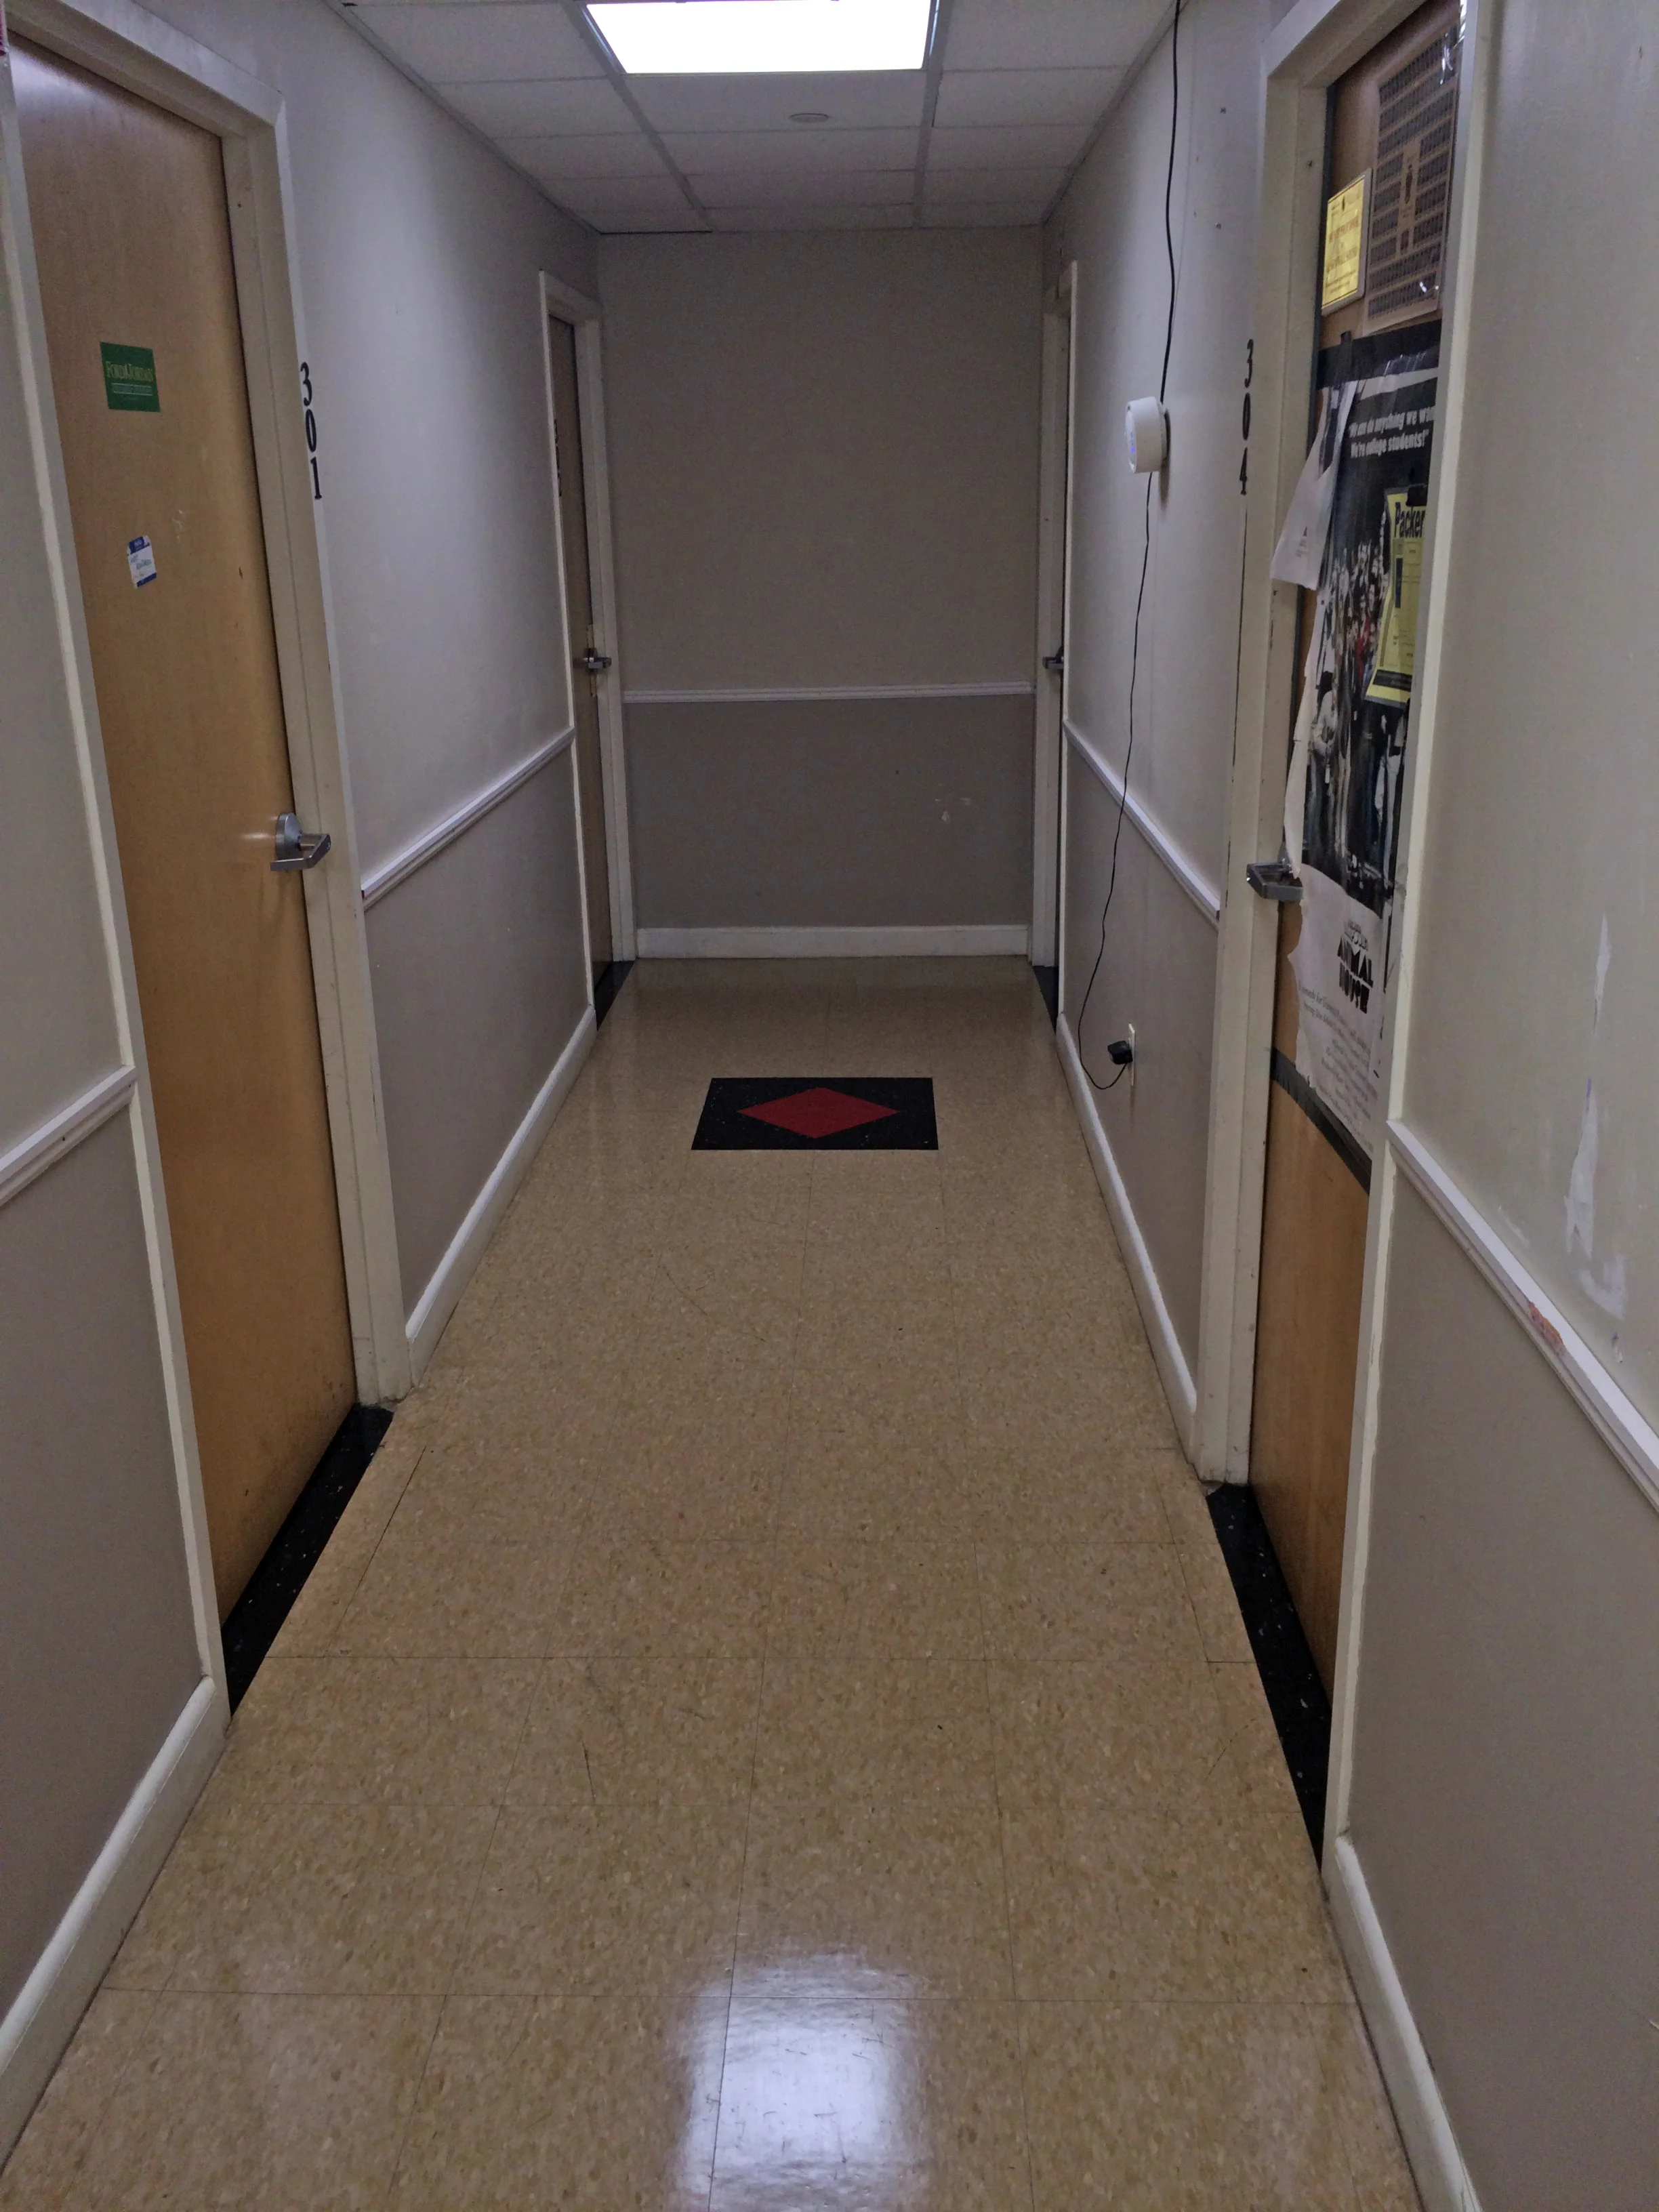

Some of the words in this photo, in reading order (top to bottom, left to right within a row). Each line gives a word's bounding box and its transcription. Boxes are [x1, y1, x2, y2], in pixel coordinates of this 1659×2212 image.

[300, 361, 322, 500] 301
[1239, 338, 1254, 496] 304
[1374, 412, 1406, 434] anything
[1406, 410, 1418, 426] we
[1337, 935, 1374, 988] ANIMAL
[1338, 961, 1370, 1014] HOUSE
